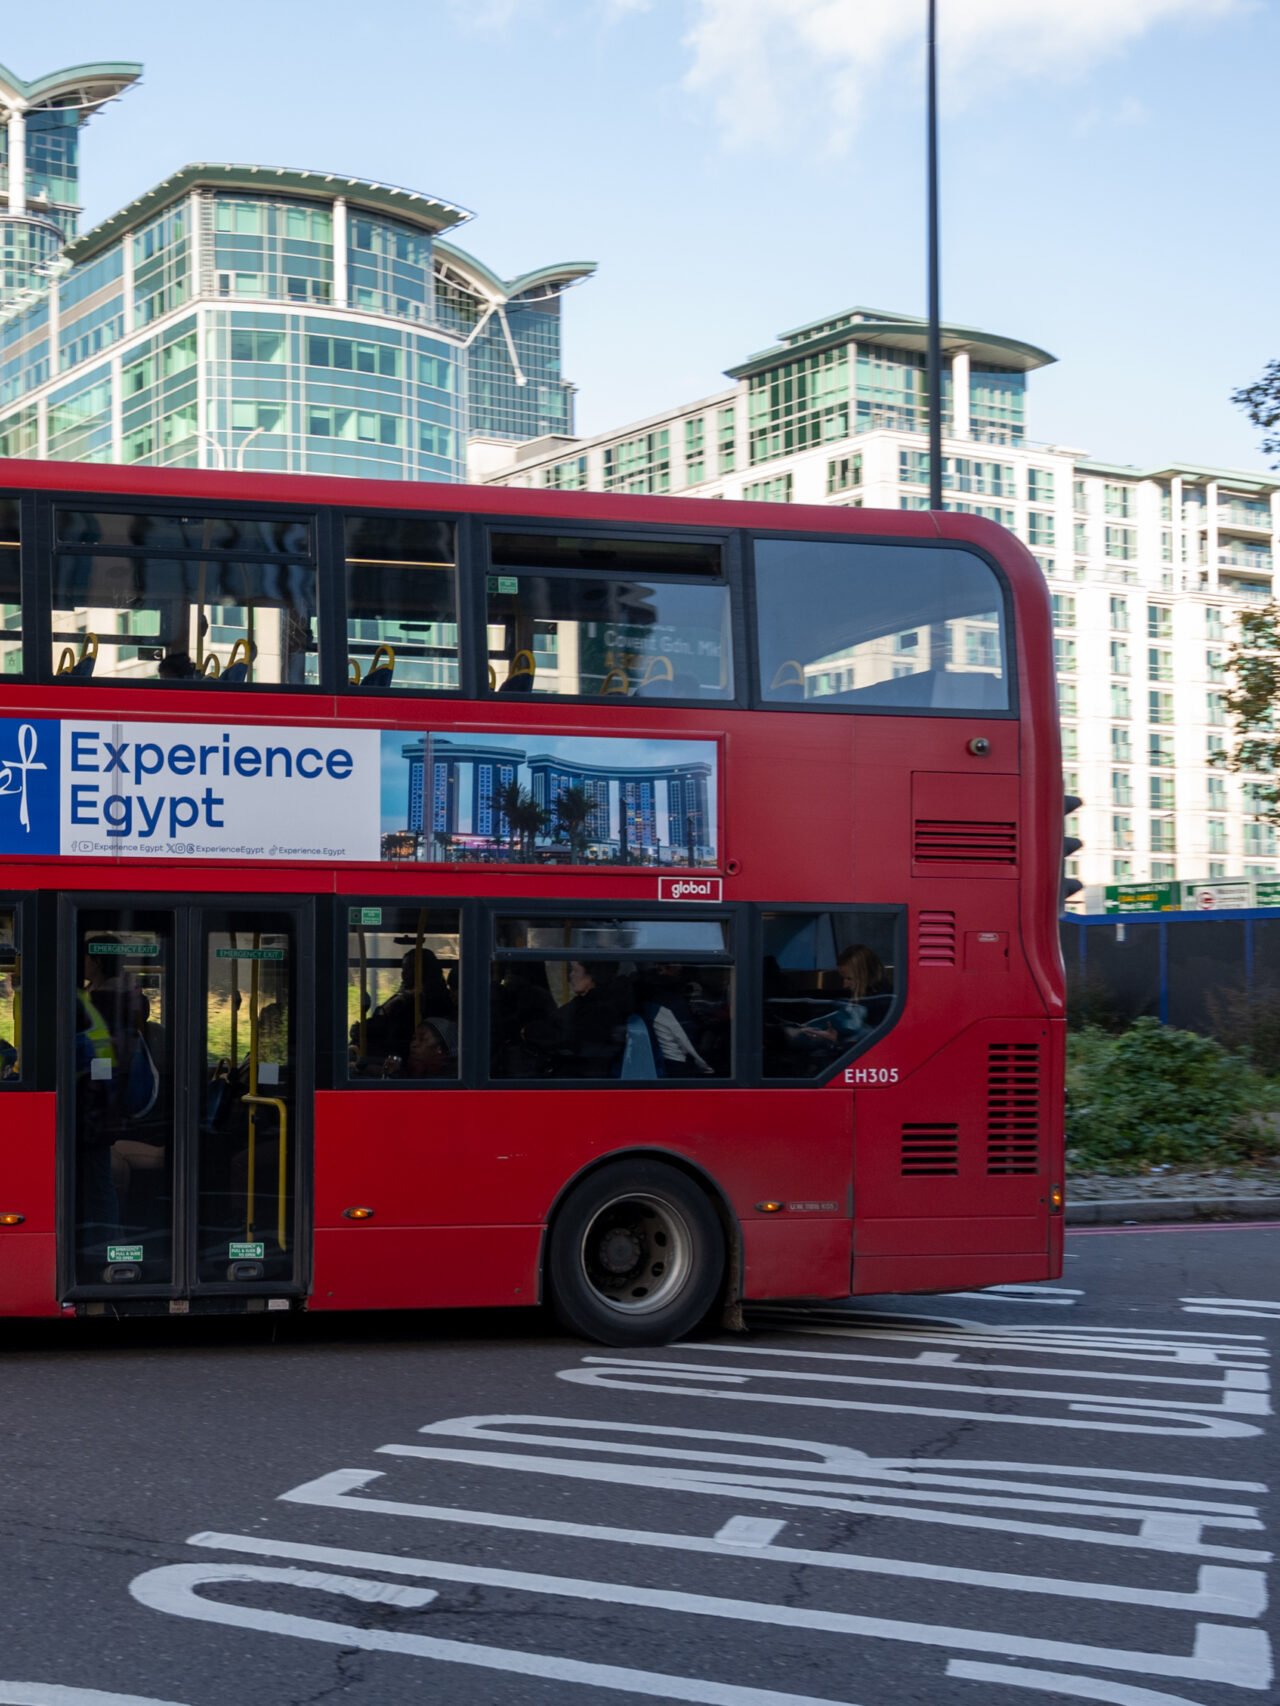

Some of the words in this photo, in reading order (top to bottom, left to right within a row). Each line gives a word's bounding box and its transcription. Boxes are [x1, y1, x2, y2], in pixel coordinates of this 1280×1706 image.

[71, 731, 353, 785] Experience
[70, 784, 224, 837] Egypt
[94, 844, 138, 852] Experience
[139, 844, 164, 853] Egypt
[195, 845, 265, 854] ExperienceEgypt
[672, 880, 711, 898] global
[93, 945, 136, 953] EMERGENCY
[138, 946, 154, 954] EXIT
[220, 949, 262, 958] EMERGENCY
[264, 951, 279, 959] EXIT
[844, 1068, 899, 1083] EH305
[556, 1306, 1274, 1439] CLEAR
[129, 1414, 1274, 1706] CLEAR
